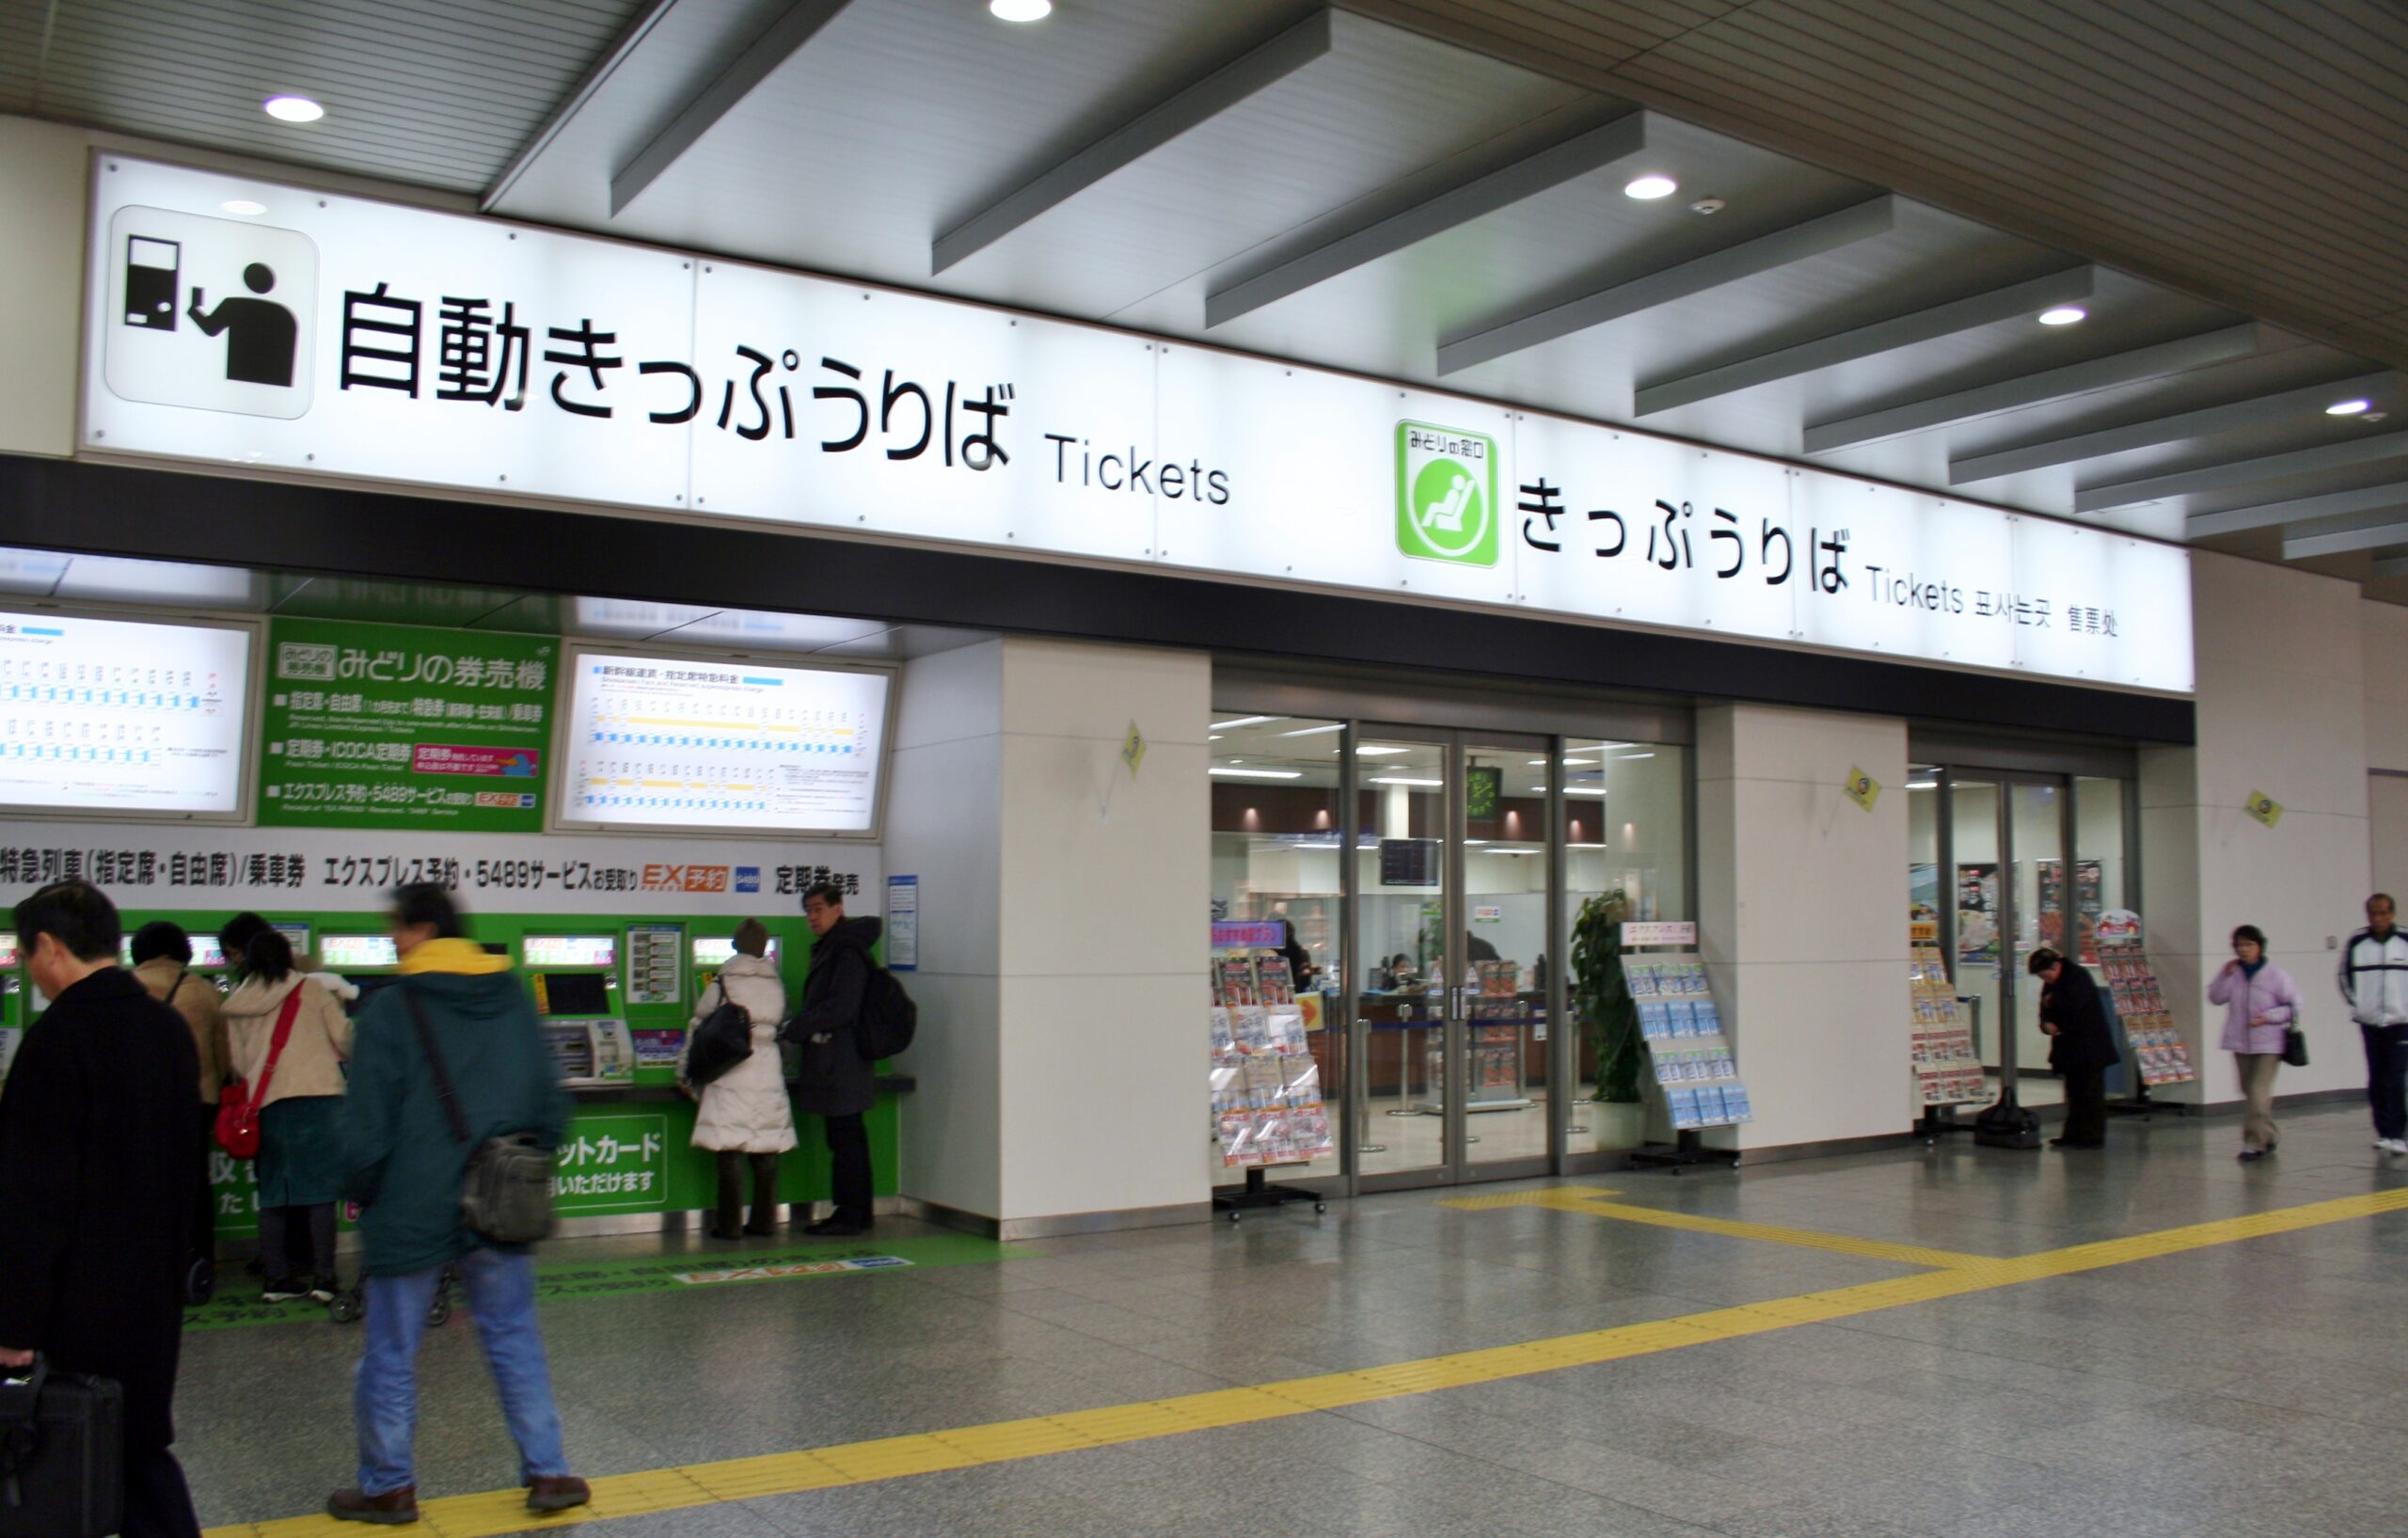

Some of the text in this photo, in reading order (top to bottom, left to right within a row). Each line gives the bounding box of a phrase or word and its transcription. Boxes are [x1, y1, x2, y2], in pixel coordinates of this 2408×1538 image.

[340, 281, 1231, 505] 自動きっぷうりば Tickets
[1411, 431, 1483, 459] みどりの窓口
[1516, 477, 1851, 595] きっぷうりば
[1865, 565, 1964, 613] Tickets
[338, 648, 547, 691] みどりの券売機
[557, 1132, 661, 1166] ットカード
